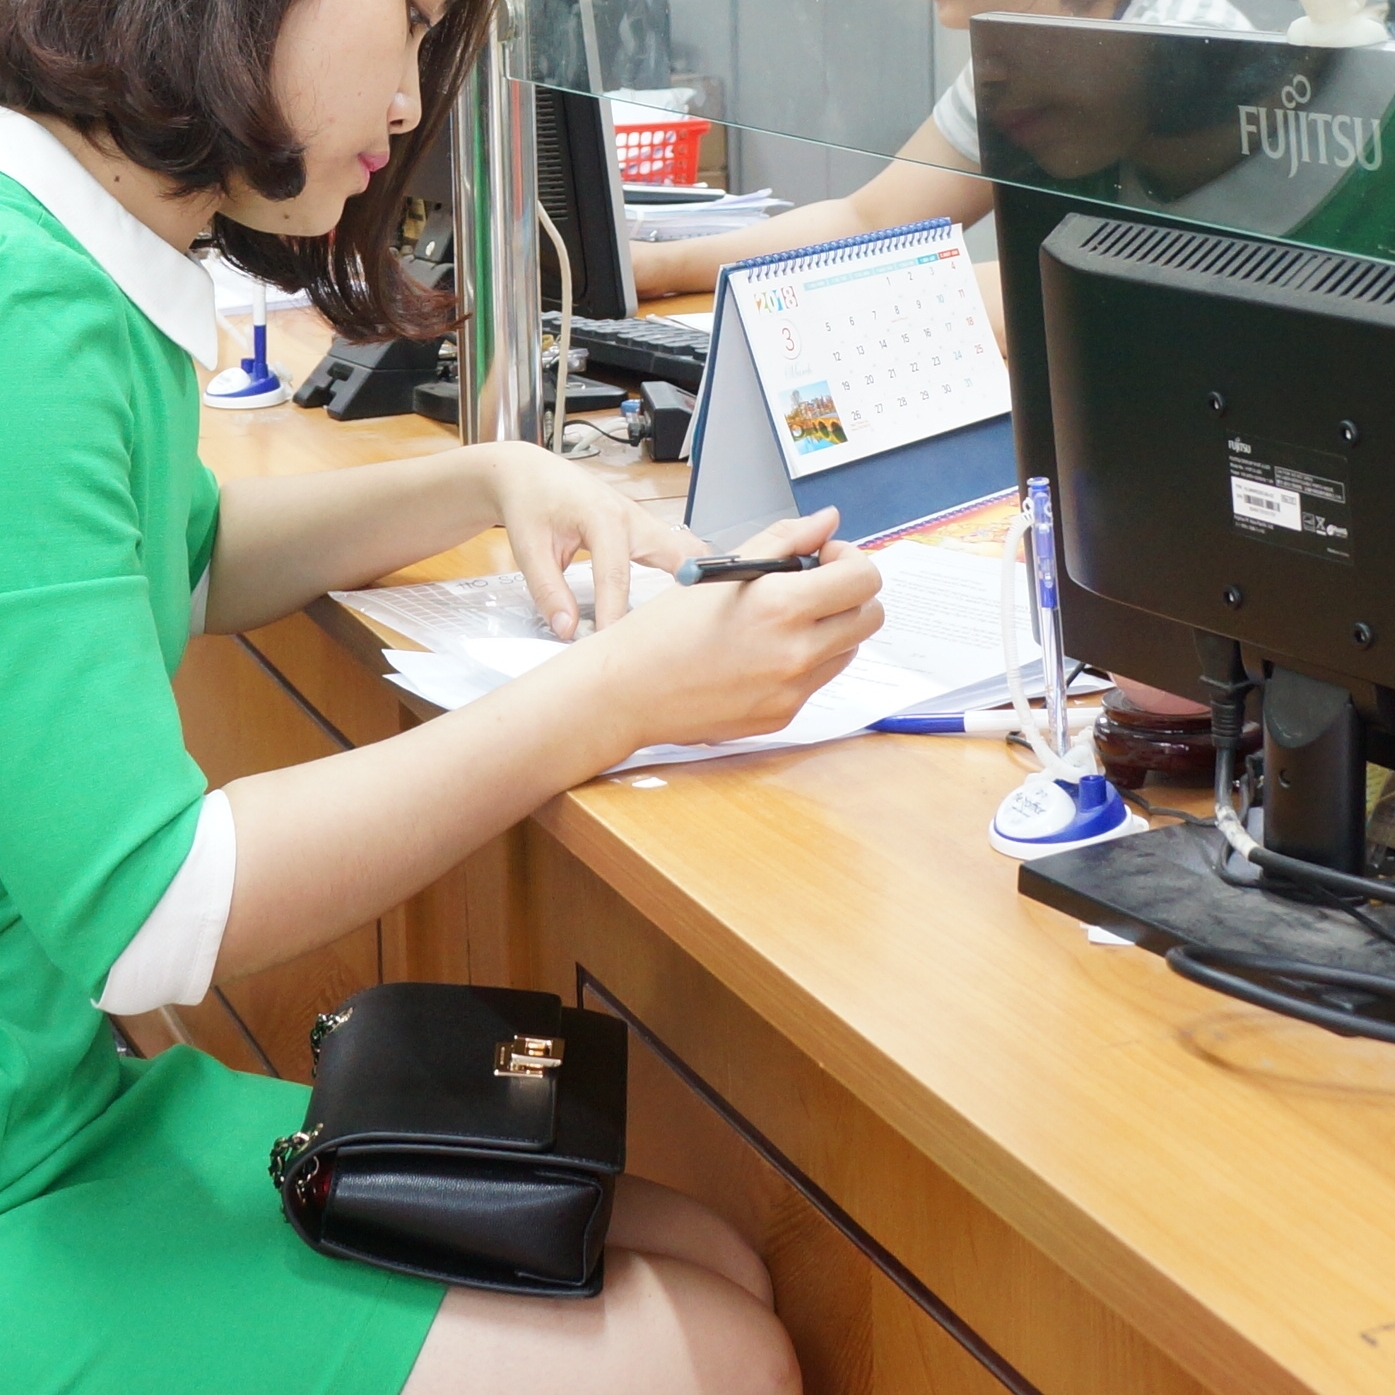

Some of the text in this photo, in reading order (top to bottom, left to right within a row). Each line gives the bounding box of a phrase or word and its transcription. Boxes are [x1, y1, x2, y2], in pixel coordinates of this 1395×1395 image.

[1237, 103, 1383, 179] FUJITSU
[907, 271, 914, 281] 2
[825, 288, 966, 332] 5 6 7 8 9 10 11
[781, 327, 795, 352] 3
[832, 316, 975, 362] 12 13 14 15 16 17 18
[841, 344, 984, 391] 19 20 21 22 23 24 25
[851, 378, 973, 421] 26 27 28 29 30 31
